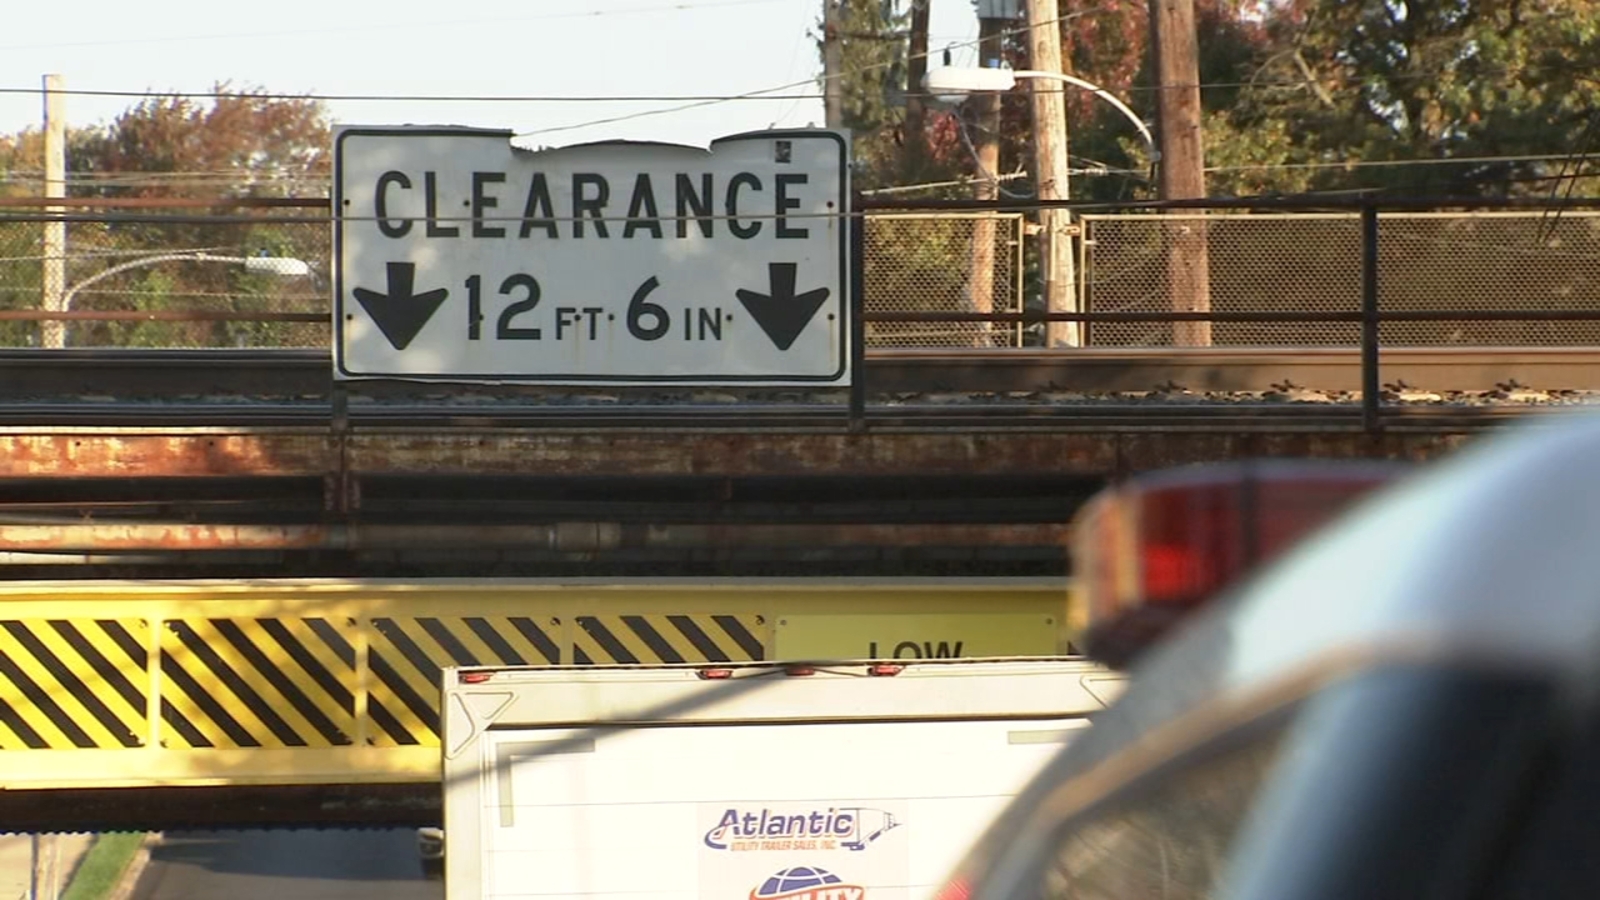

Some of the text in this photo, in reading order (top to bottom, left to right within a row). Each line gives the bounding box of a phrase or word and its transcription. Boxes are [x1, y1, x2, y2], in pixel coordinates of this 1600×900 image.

[374, 170, 810, 240] CLEARANCE
[464, 272, 723, 341] 12 FT 6 IN
[705, 808, 853, 841] Atlantic
[731, 841, 760, 851] UTILITY
[760, 840, 792, 851] TRAILER
